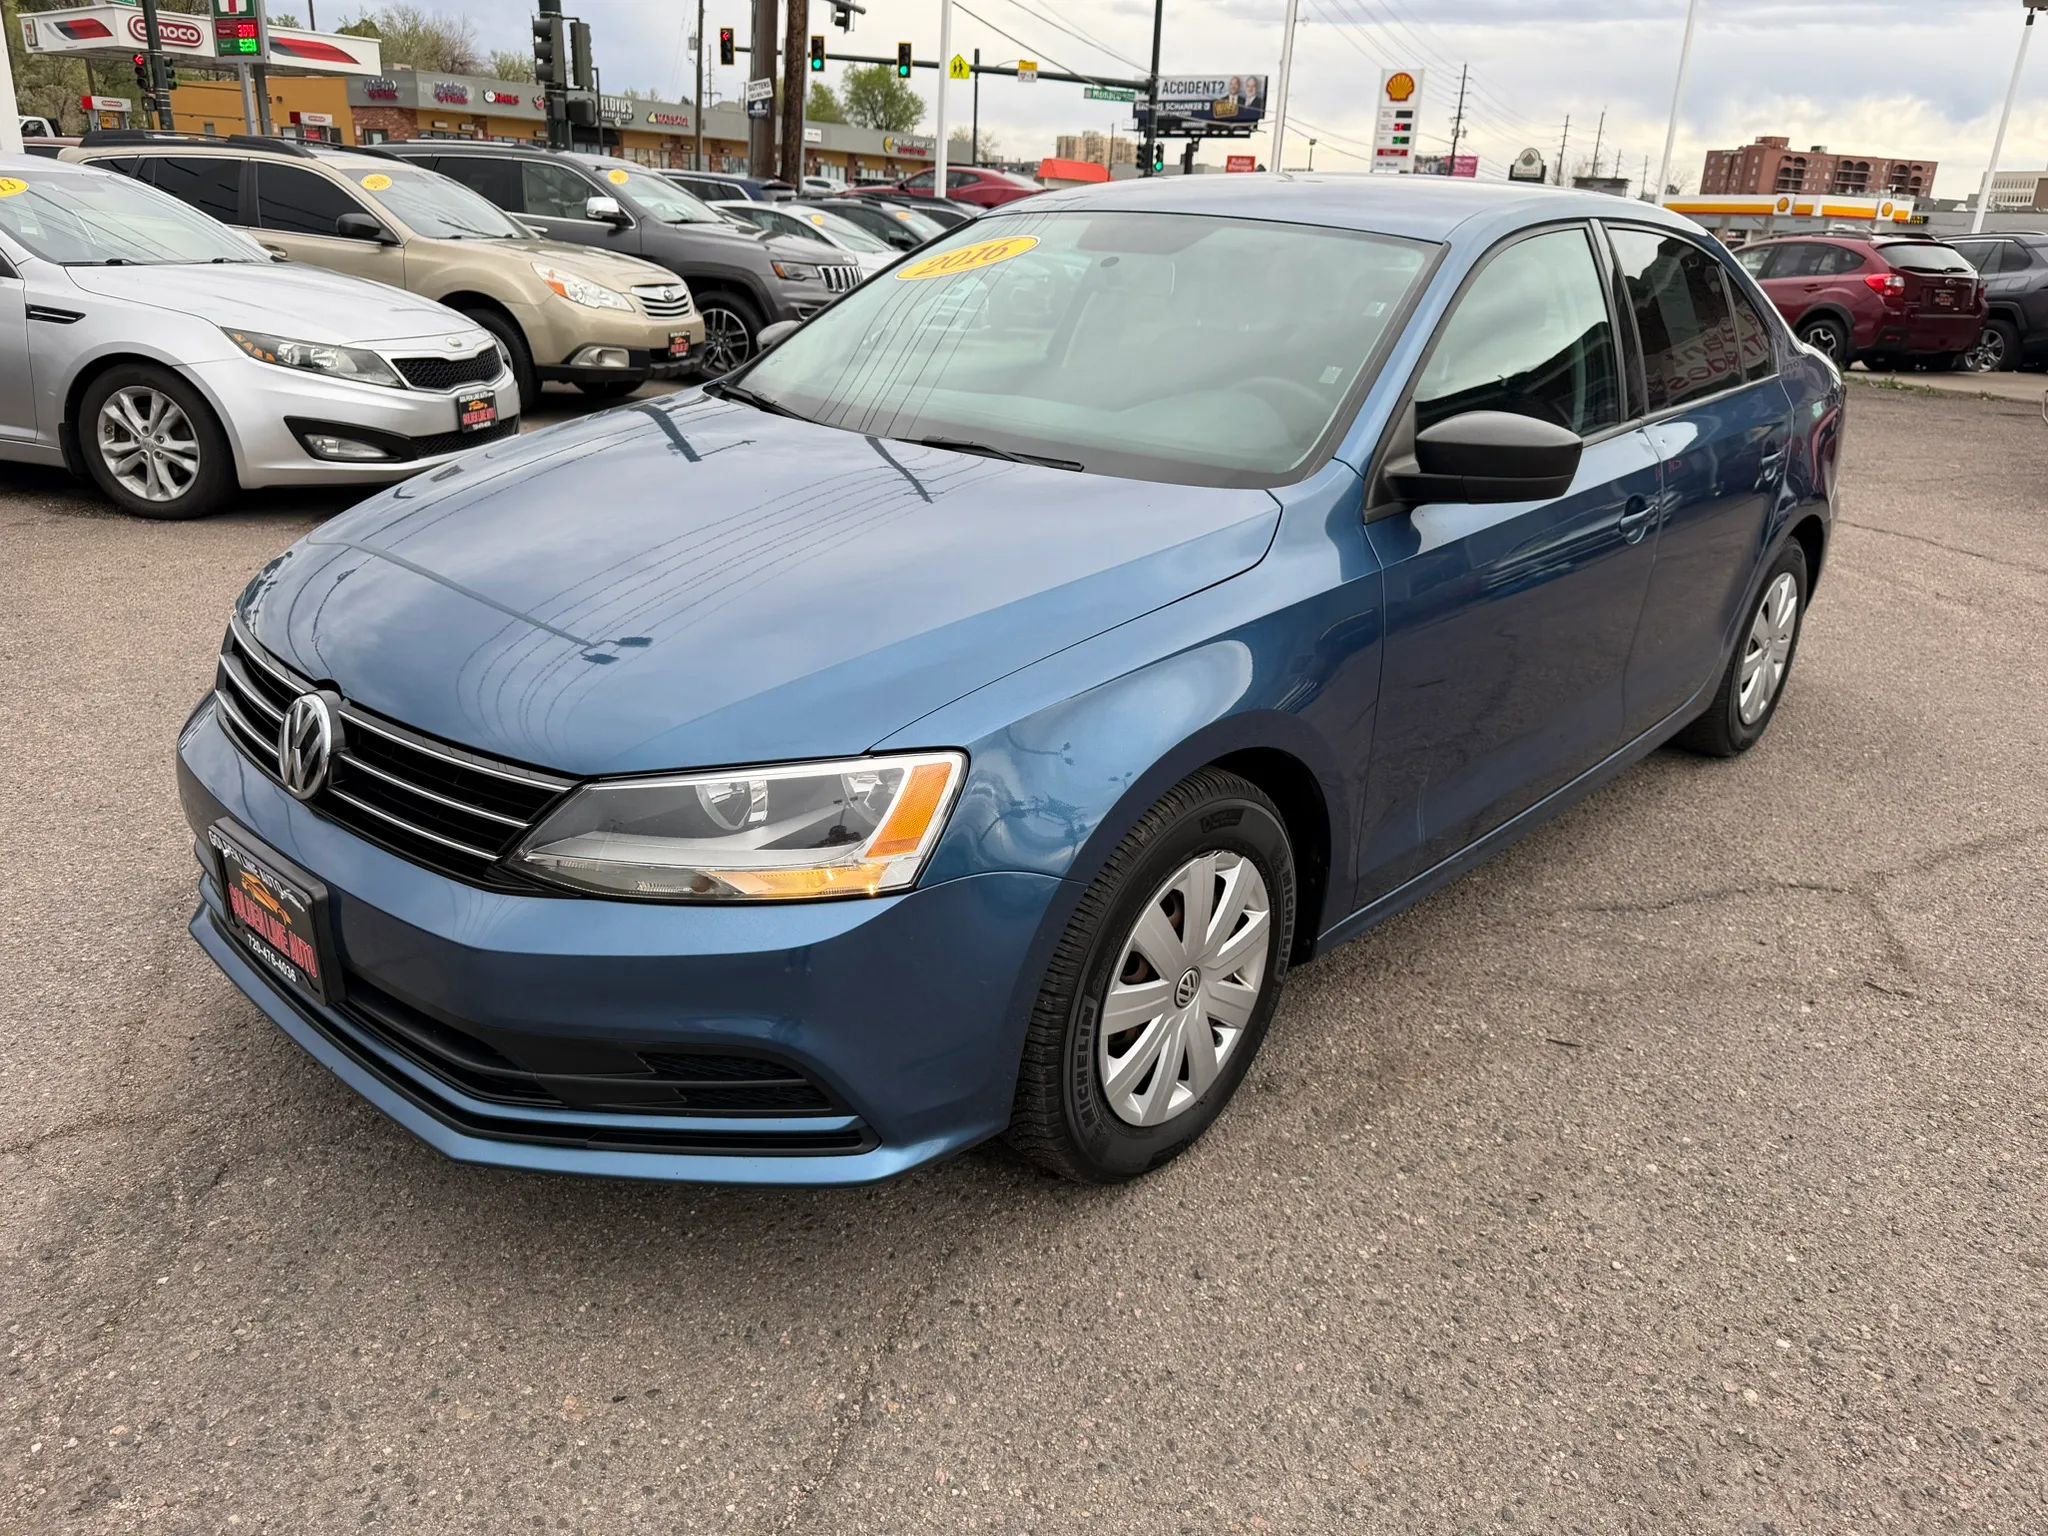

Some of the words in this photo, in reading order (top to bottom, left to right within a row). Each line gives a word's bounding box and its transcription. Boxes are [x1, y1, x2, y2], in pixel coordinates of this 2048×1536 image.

[1162, 80, 1226, 95] ACCIDENT?
[914, 238, 1020, 276] 2016
[288, 930, 319, 979] AUTO
[1077, 1006, 1096, 1129] MICHELIN
